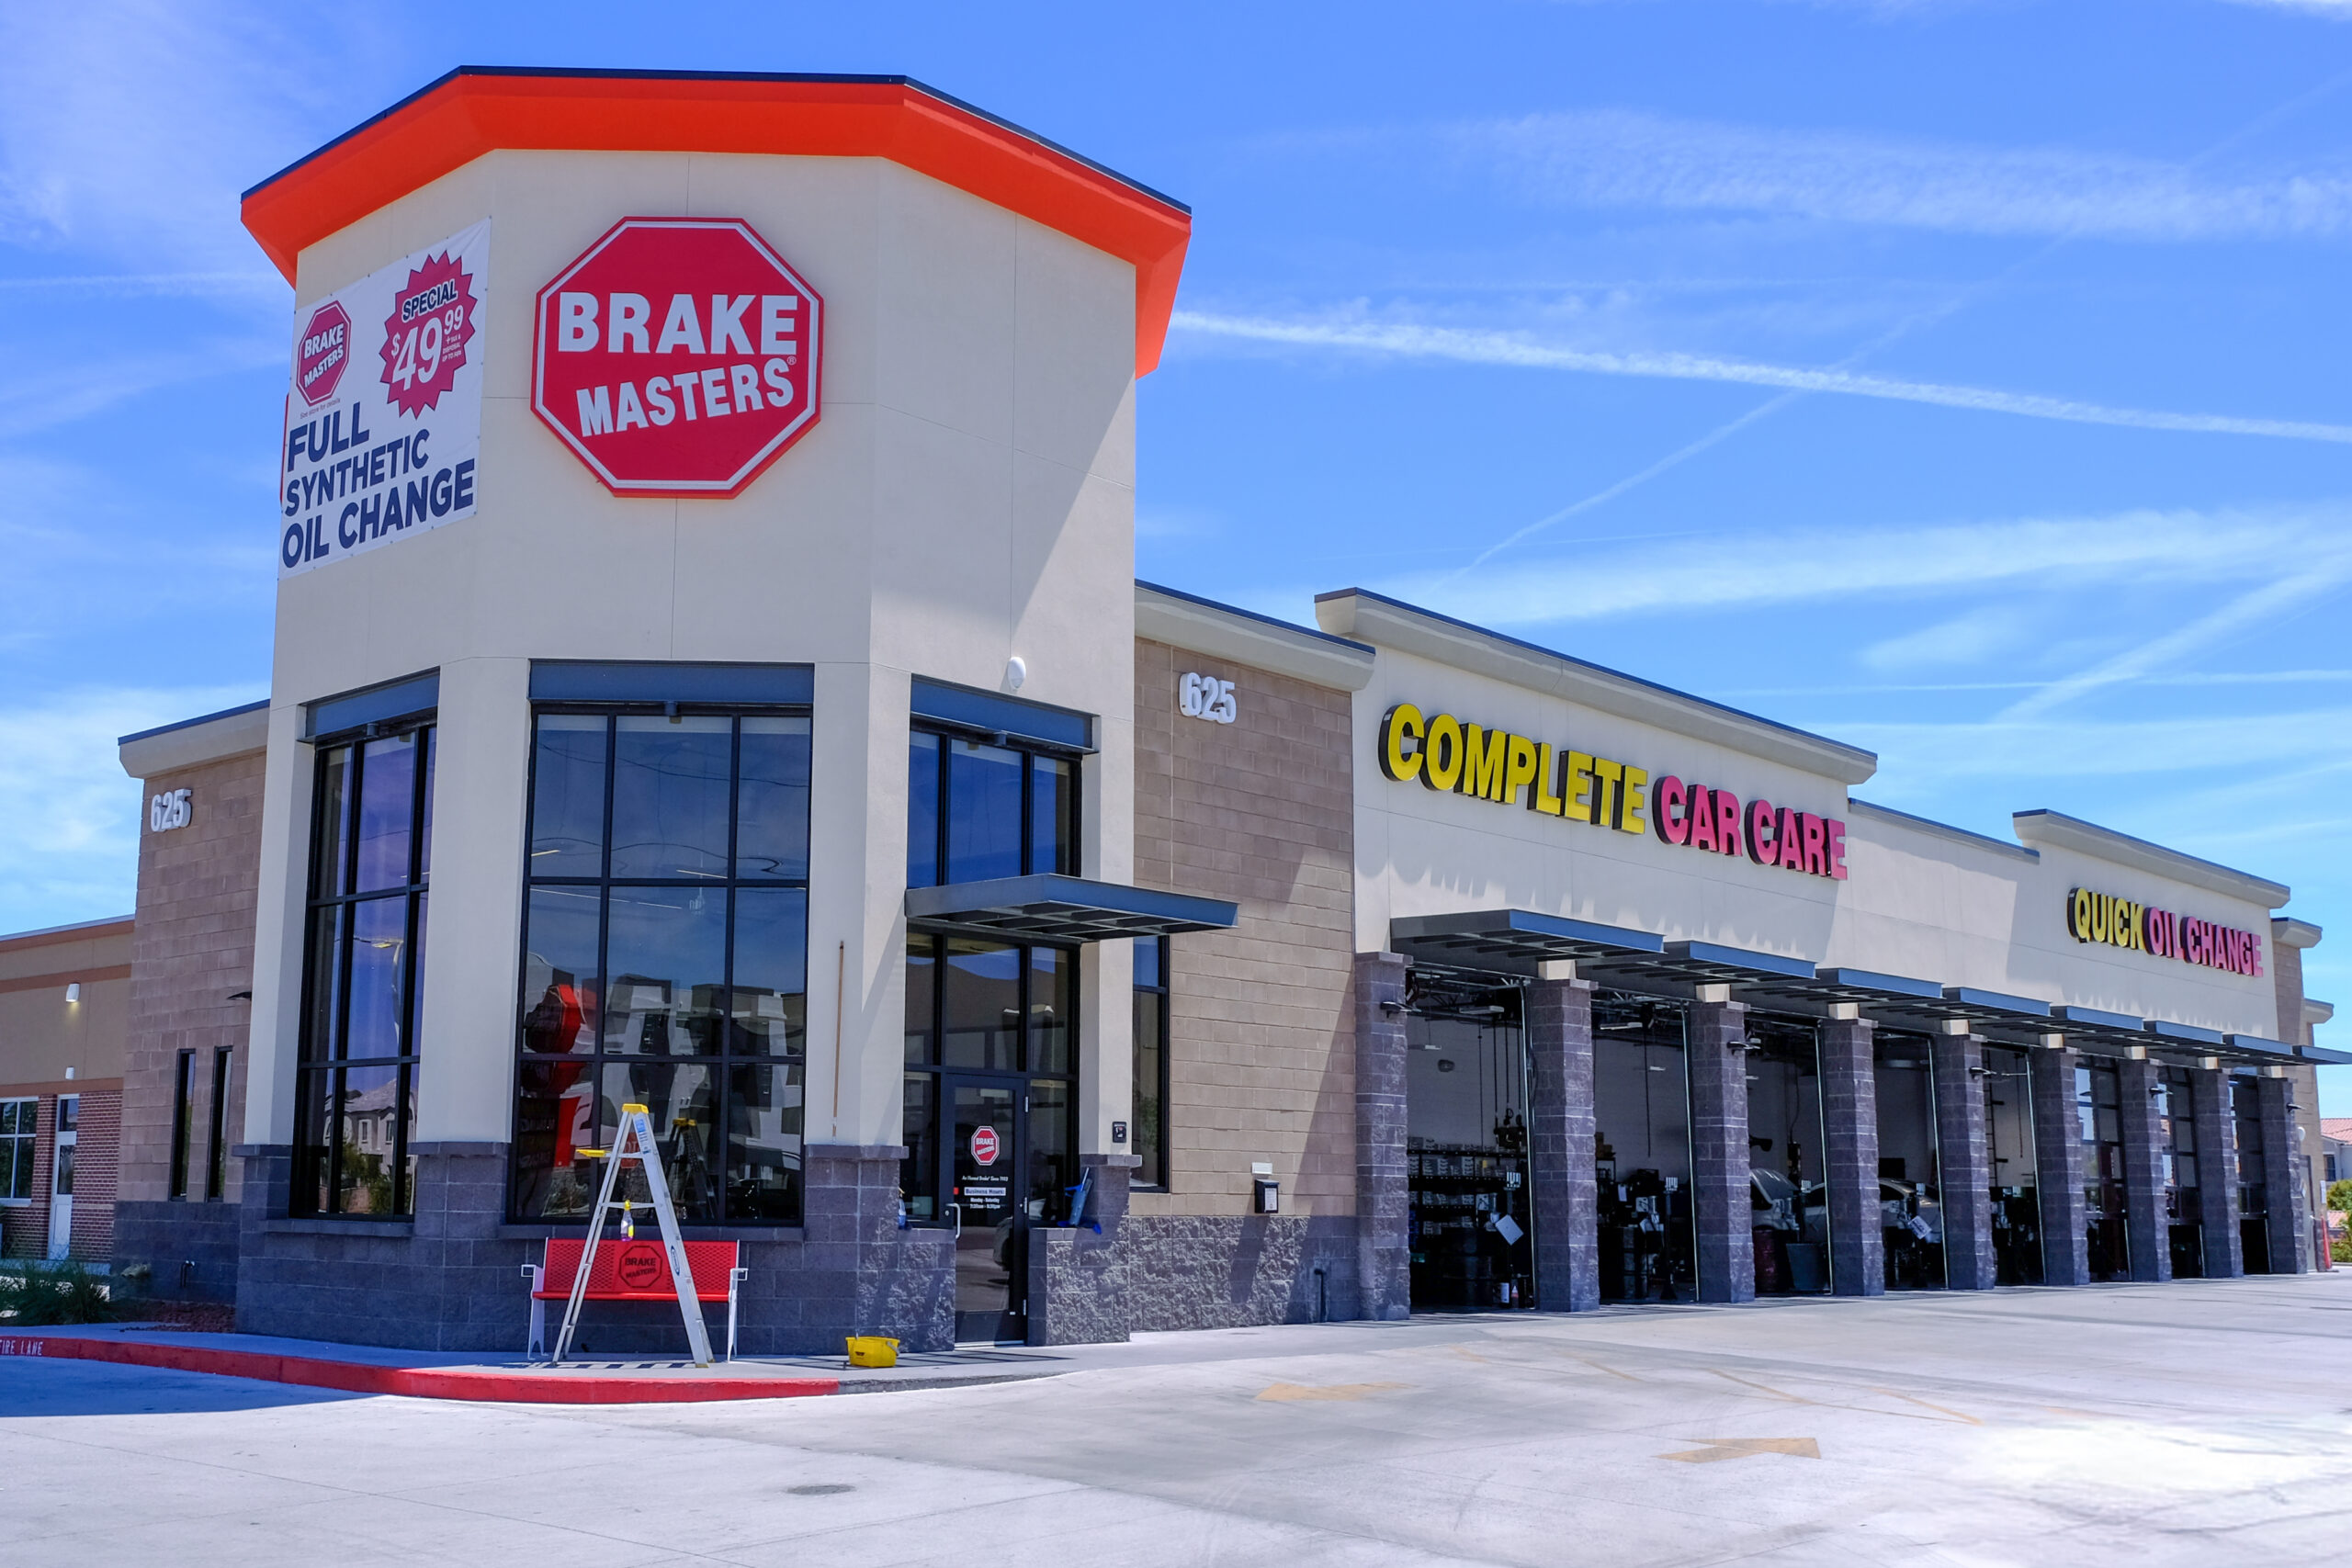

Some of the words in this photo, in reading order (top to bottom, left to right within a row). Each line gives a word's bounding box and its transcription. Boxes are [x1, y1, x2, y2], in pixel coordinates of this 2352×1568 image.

[402, 278, 458, 322] SPECIAL
[558, 291, 798, 355] BRAKE
[304, 323, 345, 359] BRAKE
[304, 344, 344, 388] MASTERS
[287, 400, 370, 472] FULL
[285, 428, 430, 517] SYNTHETIC
[281, 517, 330, 569] OIL
[338, 457, 475, 549] CHANGE
[1180, 671, 1237, 724] 625
[151, 789, 192, 832] 625
[1379, 704, 1648, 835] COMPLETE
[1653, 774, 1742, 857] CAR
[1746, 799, 1848, 881] CARE
[2067, 887, 2145, 951] QUICK
[2143, 907, 2185, 961] OIL
[2180, 916, 2264, 978] CHANGE
[976, 1137, 994, 1145] BRAKE
[625, 1258, 656, 1266] BRAKE
[20, 1340, 43, 1356] LANE
